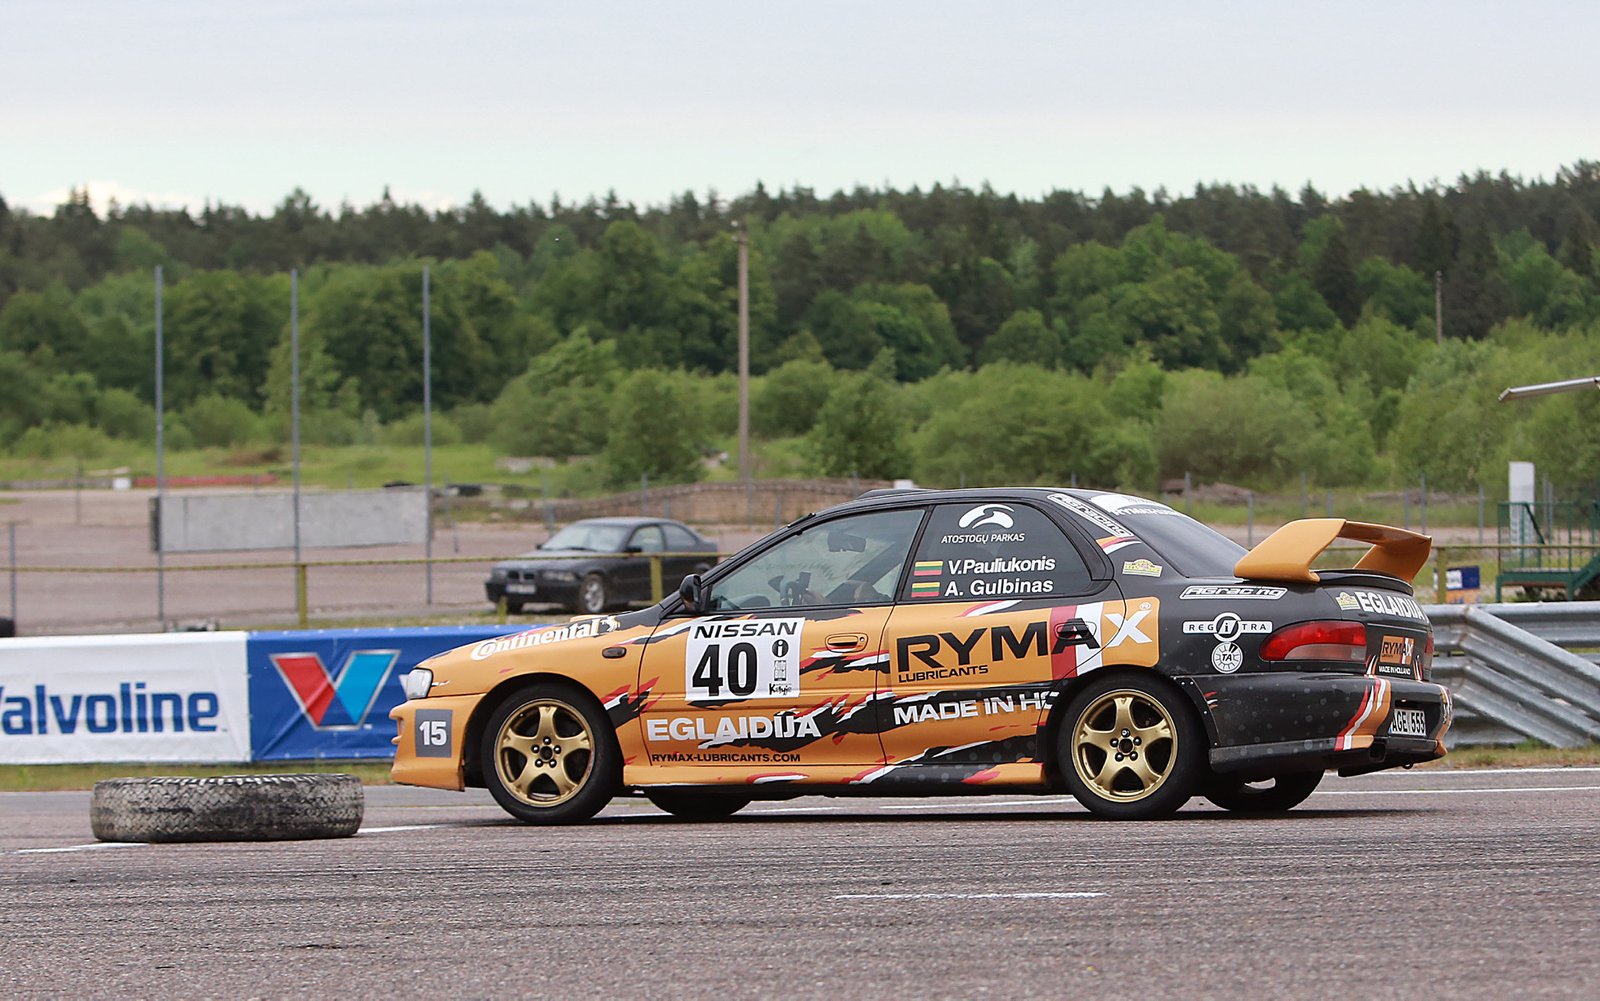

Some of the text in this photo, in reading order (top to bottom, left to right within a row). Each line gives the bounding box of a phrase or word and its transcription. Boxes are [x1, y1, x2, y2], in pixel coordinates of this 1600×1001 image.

[991, 533, 1026, 542] PARKAS
[948, 556, 1056, 575] V.Pauliukonis
[944, 578, 1054, 597] A. Gulbinas
[471, 618, 600, 660] Continental
[694, 622, 798, 639] NISSAN
[896, 609, 1153, 672] RYMAX
[1382, 641, 1413, 657] RYMAX
[1221, 653, 1233, 662] TA
[692, 642, 758, 697] 40
[898, 664, 989, 683] LUBRICANTS
[0, 682, 220, 736] alvoline
[894, 699, 979, 725] MADE
[984, 695, 1015, 716] IN
[419, 720, 447, 746] 15
[646, 716, 822, 742] EGLAIDIJA
[651, 753, 801, 763] RYMAX-LUBRICANTS.COM
